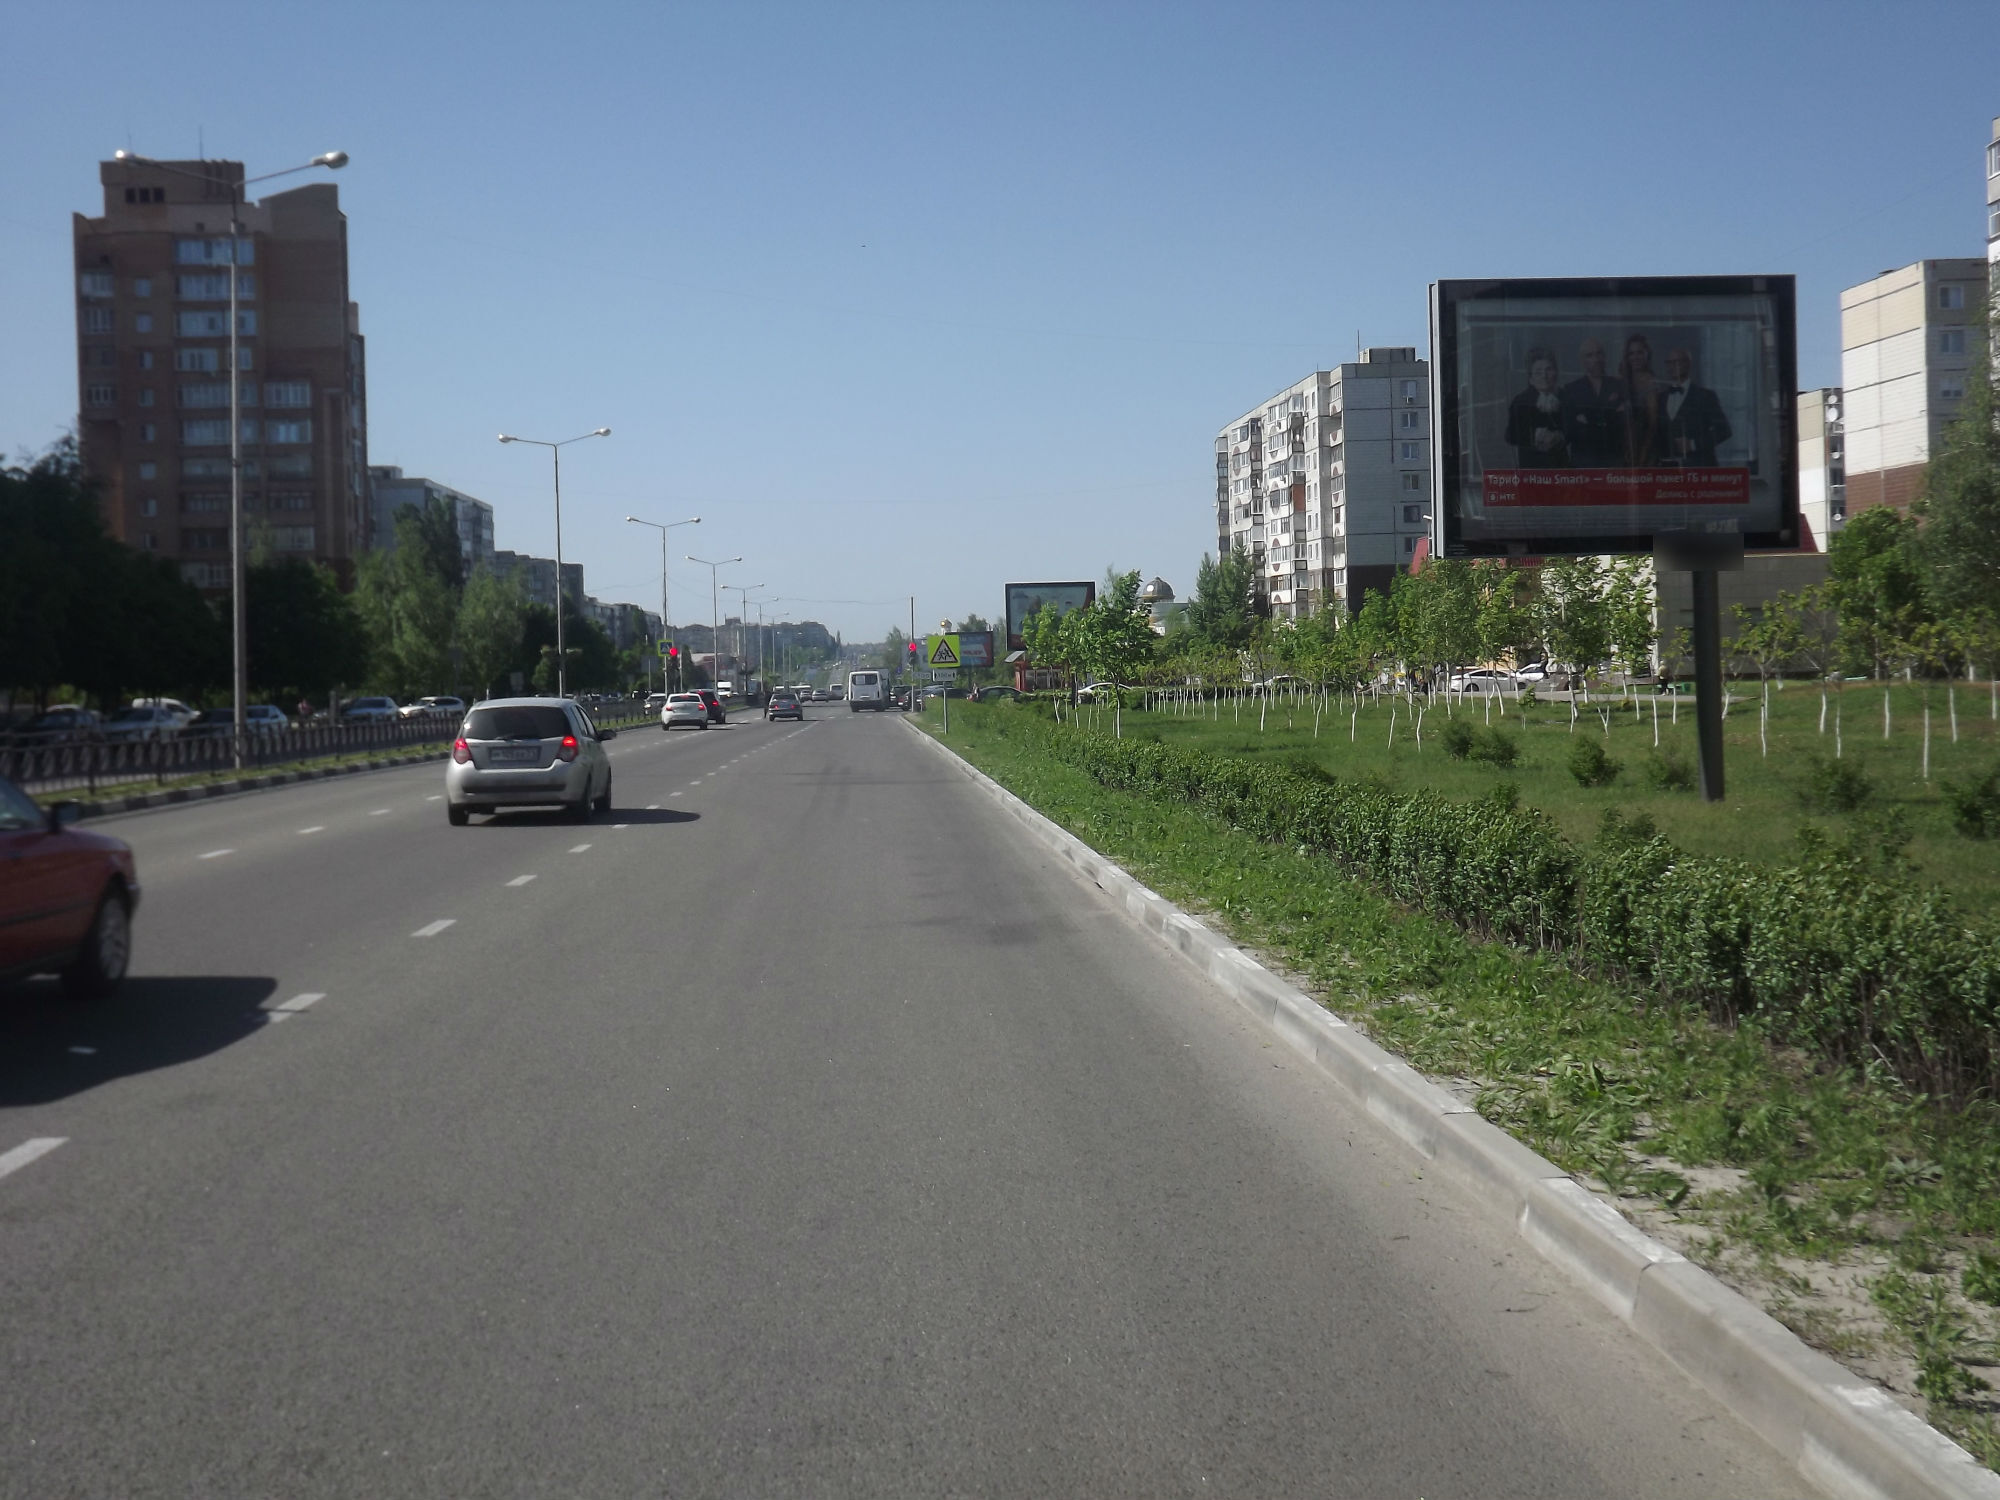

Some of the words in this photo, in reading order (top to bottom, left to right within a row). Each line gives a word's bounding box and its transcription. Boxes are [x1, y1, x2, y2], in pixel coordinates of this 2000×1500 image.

[1487, 474, 1520, 486] Тариф
[1605, 472, 1653, 484] большой
[1655, 473, 1684, 483] пакет
[1701, 474, 1708, 483] и
[1710, 473, 1743, 485] минут
